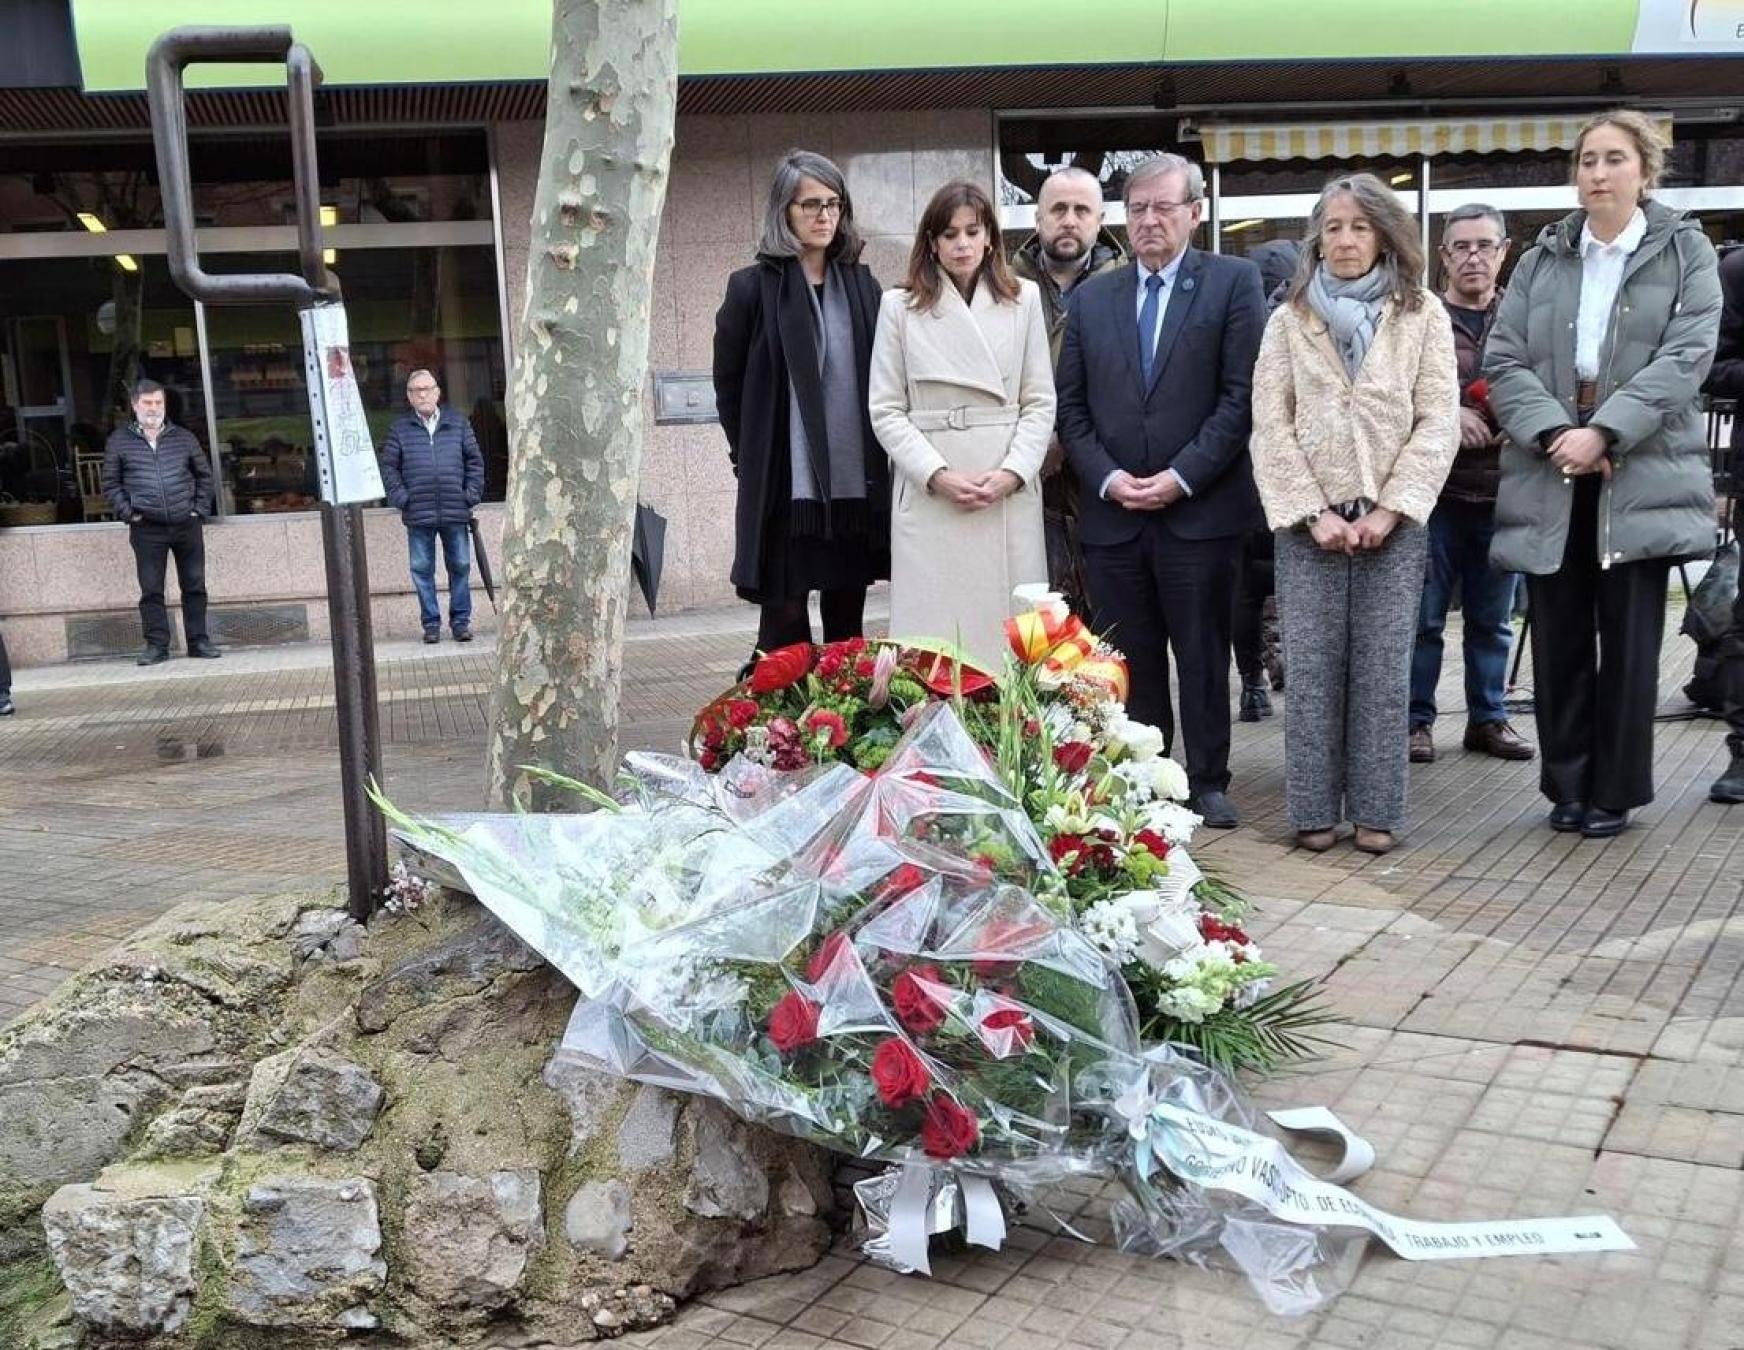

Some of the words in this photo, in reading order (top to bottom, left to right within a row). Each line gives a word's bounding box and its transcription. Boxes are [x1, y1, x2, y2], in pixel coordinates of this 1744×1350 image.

[1315, 1196, 1338, 1212] DE
[1405, 1232, 1469, 1249] TRABAJO
[1471, 1235, 1483, 1248] Y
[1484, 1232, 1545, 1247] EMPLEO
